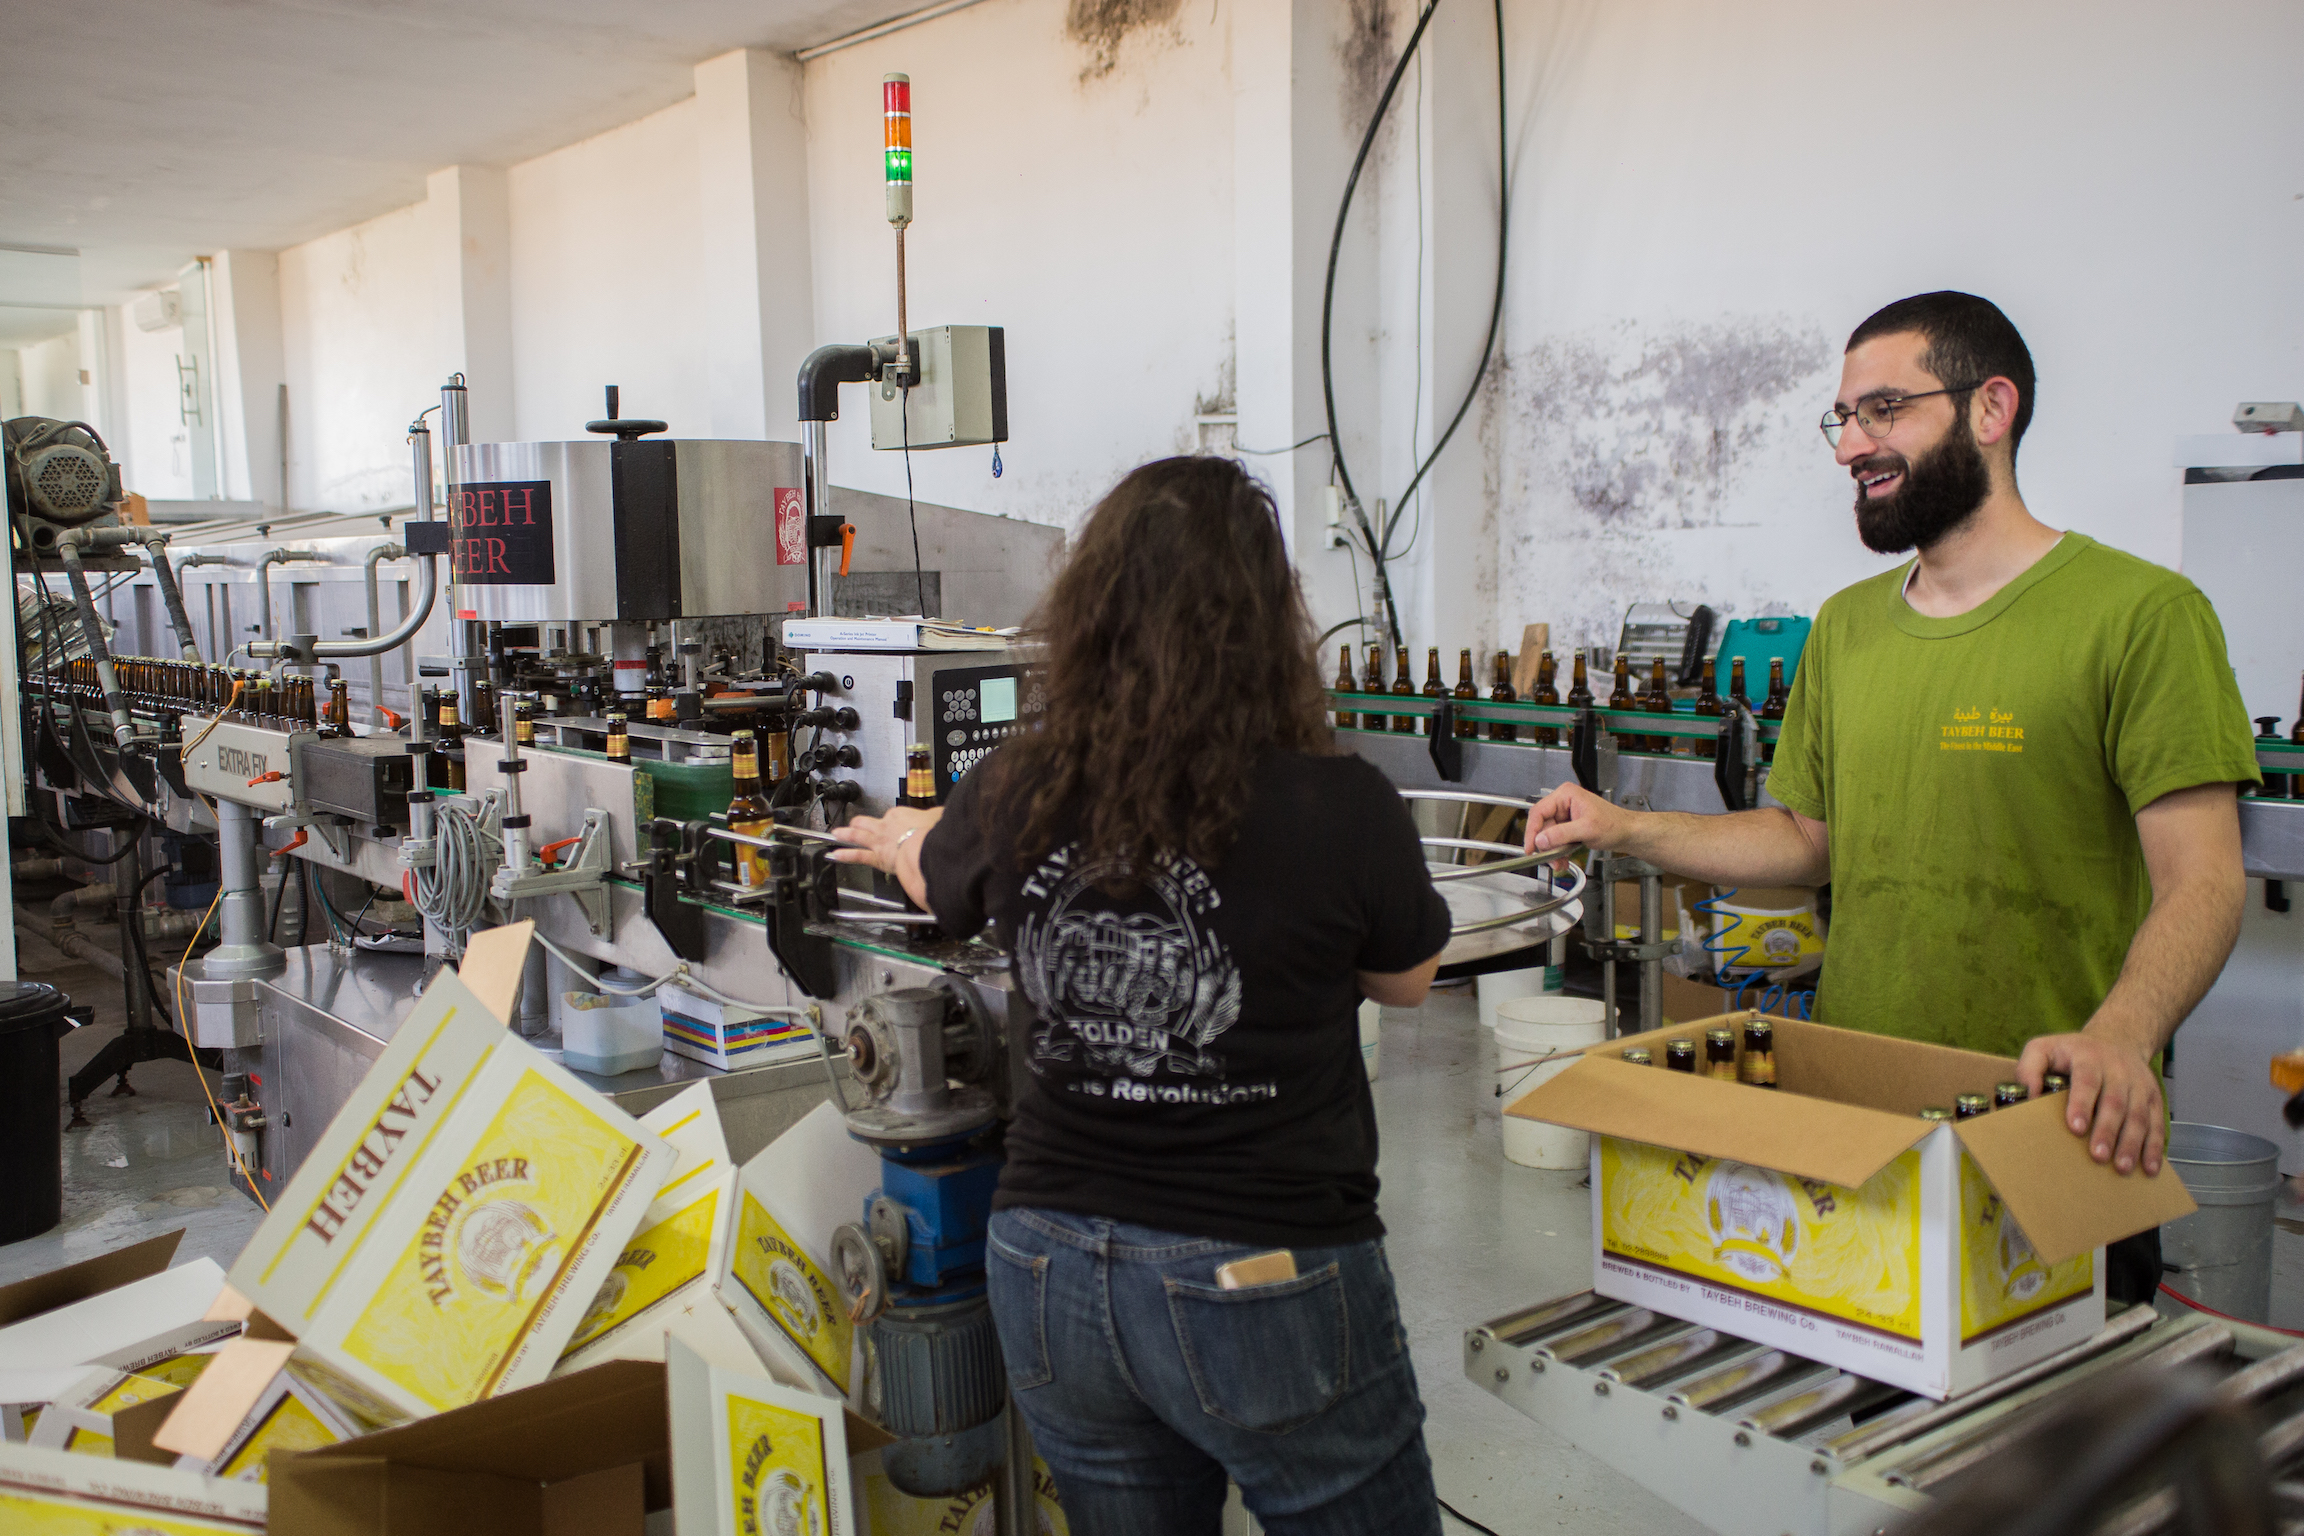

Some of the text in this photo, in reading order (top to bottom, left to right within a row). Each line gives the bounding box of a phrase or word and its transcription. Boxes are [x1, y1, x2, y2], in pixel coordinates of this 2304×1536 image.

[593, 685, 600, 695] 5
[218, 744, 268, 778] EXTRA FIX
[1941, 726, 2025, 740] TAYBEH BEER
[1750, 919, 1787, 941] TAYBEH
[306, 1066, 442, 1248] TAYBEH
[419, 1157, 529, 1307] TAYBEH BEER
[531, 1295, 560, 1336] TAYBEH
[558, 1247, 592, 1296] BREWING
[756, 1235, 838, 1327] TAYBEH BEER
[1602, 1261, 1634, 1278] BREWED
[1643, 1272, 1679, 1291] BOTTLED
[1679, 1282, 1691, 1294] BY
[1700, 1287, 1742, 1310] TAYBEH
[1744, 1300, 1797, 1326] BREWING
[1835, 1328, 1871, 1347] TAYBEH
[1872, 1338, 1925, 1364] RAMALLAH
[147, 1346, 177, 1363] TAYBEH
[741, 1433, 774, 1491] BEER
